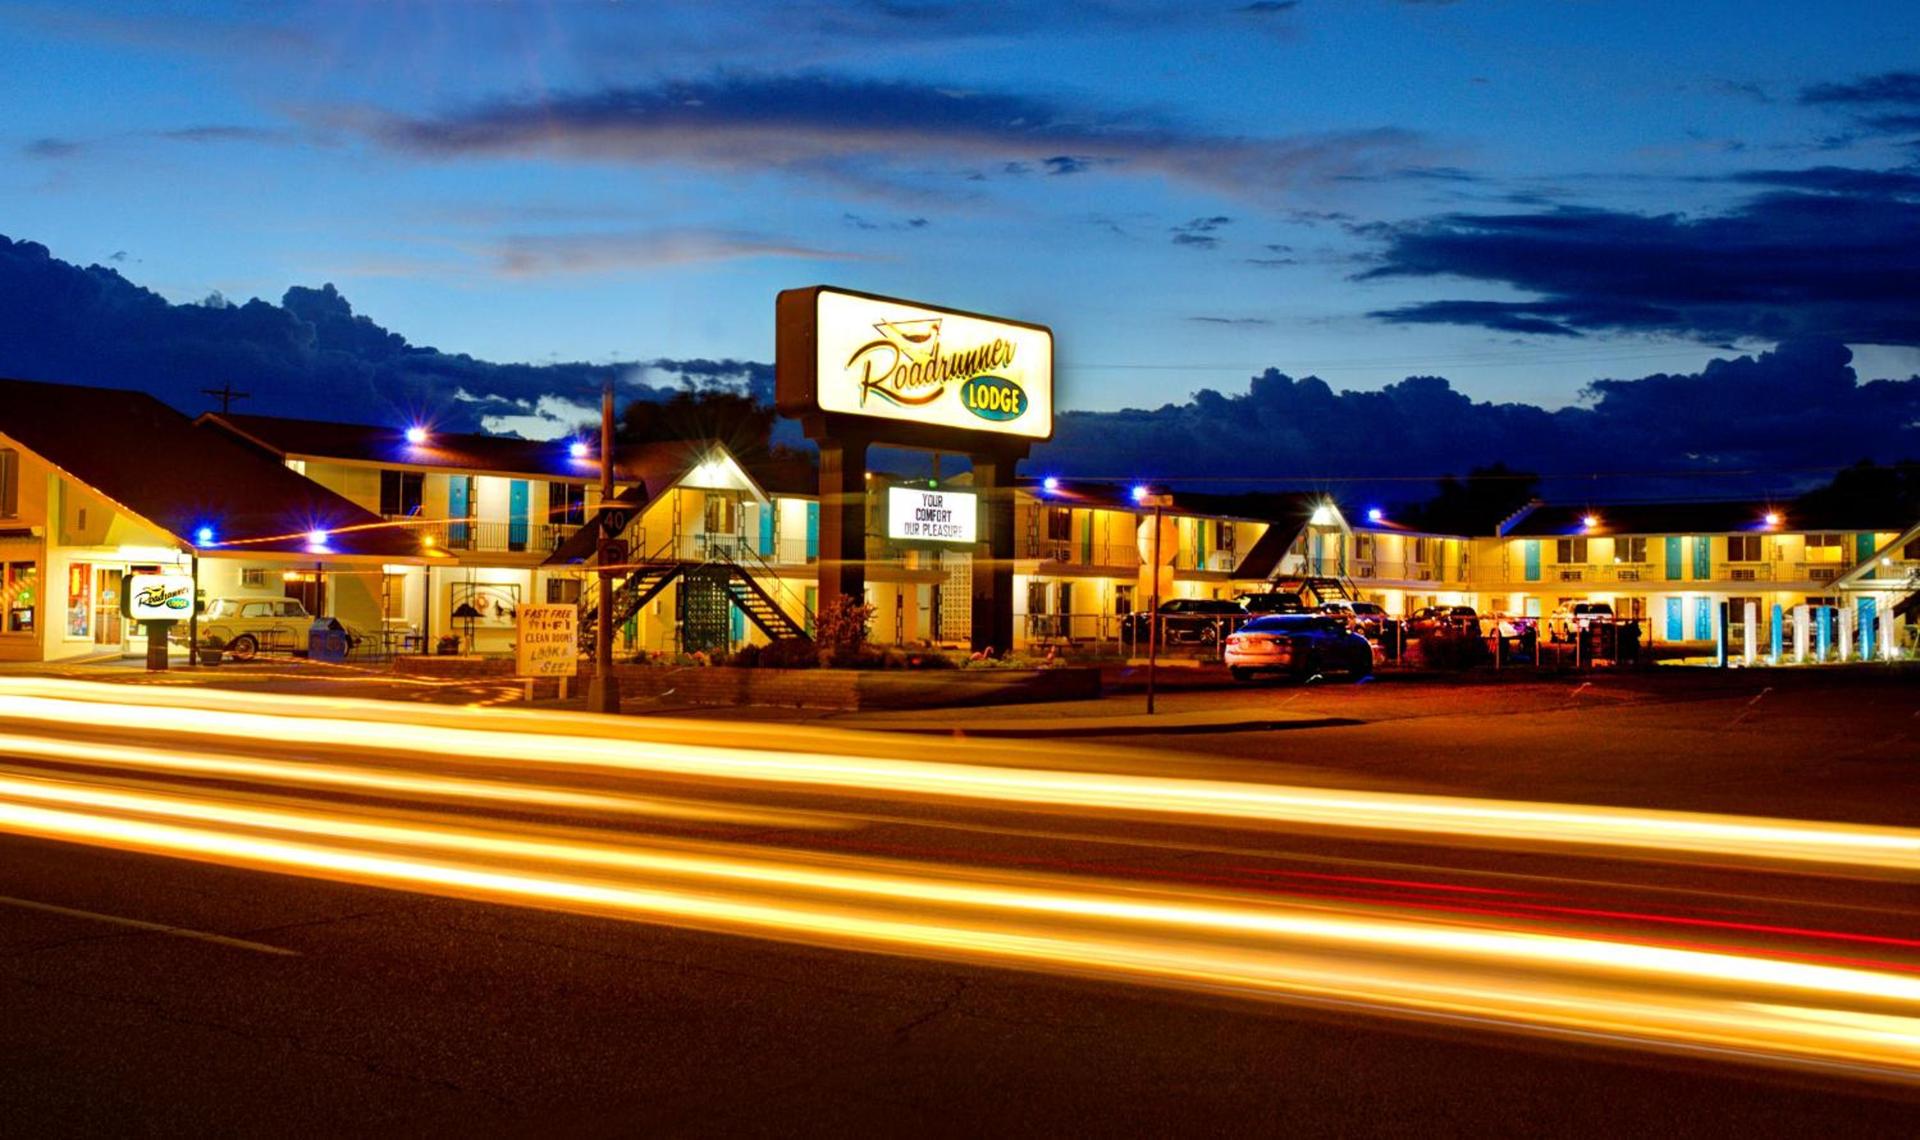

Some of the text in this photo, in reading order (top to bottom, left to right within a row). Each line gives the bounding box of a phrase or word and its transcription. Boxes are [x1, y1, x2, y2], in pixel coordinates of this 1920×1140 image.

[845, 338, 1017, 407] Roadrunner
[968, 383, 1020, 414] LODGE
[922, 493, 943, 508] YOUR
[604, 511, 624, 530] 40
[915, 507, 952, 523] COMFORT
[904, 522, 963, 538] OUR PLEASURE
[524, 608, 573, 619] FAST FREE
[525, 632, 574, 643] CLEAN ROOMS
[530, 645, 560, 661] LOOK
